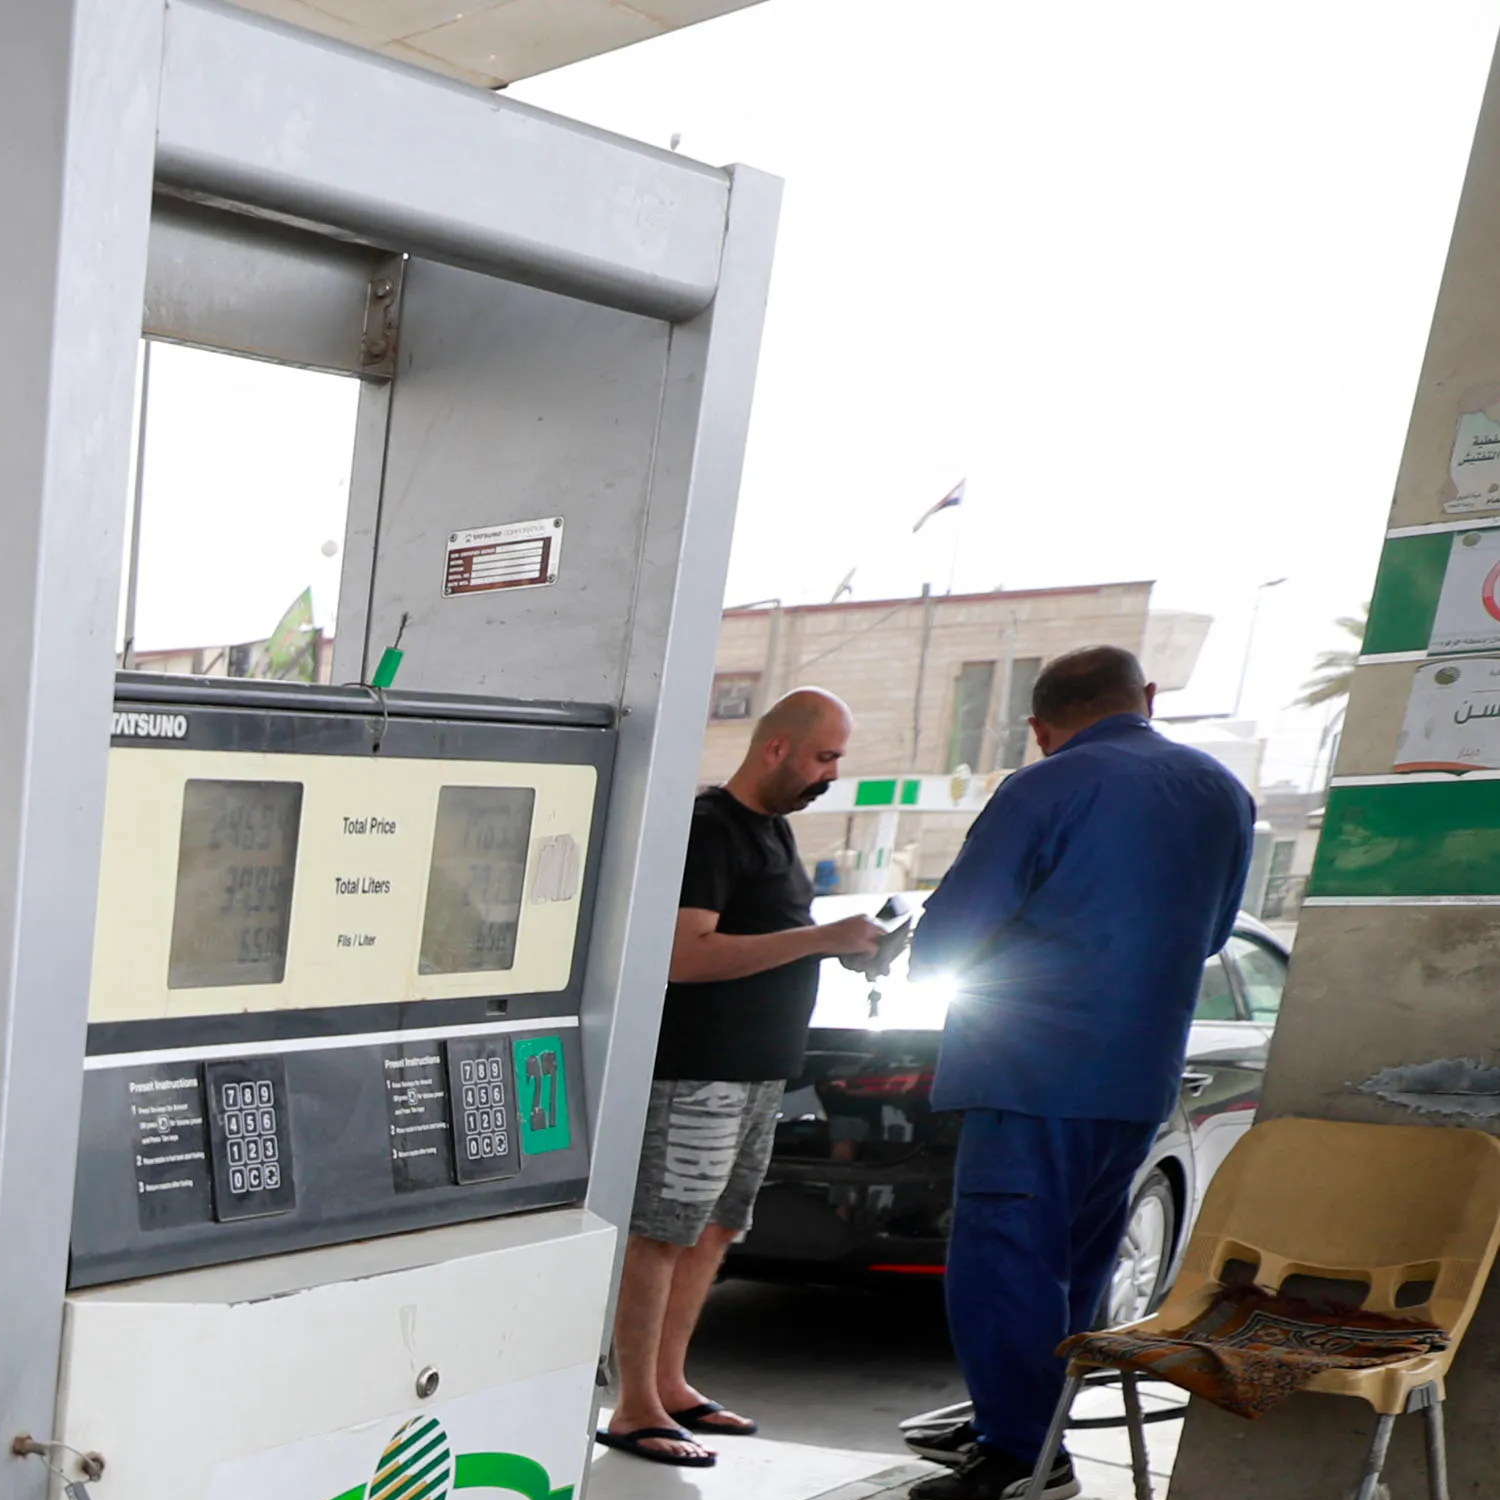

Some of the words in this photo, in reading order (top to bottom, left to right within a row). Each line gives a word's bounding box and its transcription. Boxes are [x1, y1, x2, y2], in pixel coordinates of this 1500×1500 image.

[343, 817, 368, 834] Total
[370, 817, 396, 834] Price
[335, 877, 360, 894] Total
[361, 877, 390, 893] Liters
[358, 934, 376, 946] Liter
[405, 1055, 440, 1067] Instructions
[464, 1066, 471, 1079] 7
[478, 1064, 485, 1078] 8
[492, 1063, 499, 1076] 9
[129, 1082, 153, 1093] Preset
[154, 1077, 198, 1090] Instructions
[227, 1090, 235, 1104] 7
[244, 1088, 252, 1103] 8
[260, 1087, 268, 1101] 9
[467, 1090, 474, 1104] 4
[480, 1089, 487, 1101] 5
[493, 1087, 500, 1100] 6
[230, 1118, 238, 1132] 4
[246, 1116, 254, 1130] 5
[263, 1114, 271, 1128] 6
[469, 1116, 475, 1128] 1
[482, 1114, 489, 1127] 2
[496, 1113, 502, 1125] 3
[232, 1145, 239, 1159] 1
[249, 1143, 257, 1158] 2
[265, 1142, 273, 1156] 3
[484, 1139, 491, 1152] C
[660, 1113, 742, 1203] NBA
[251, 1171, 260, 1185] C
